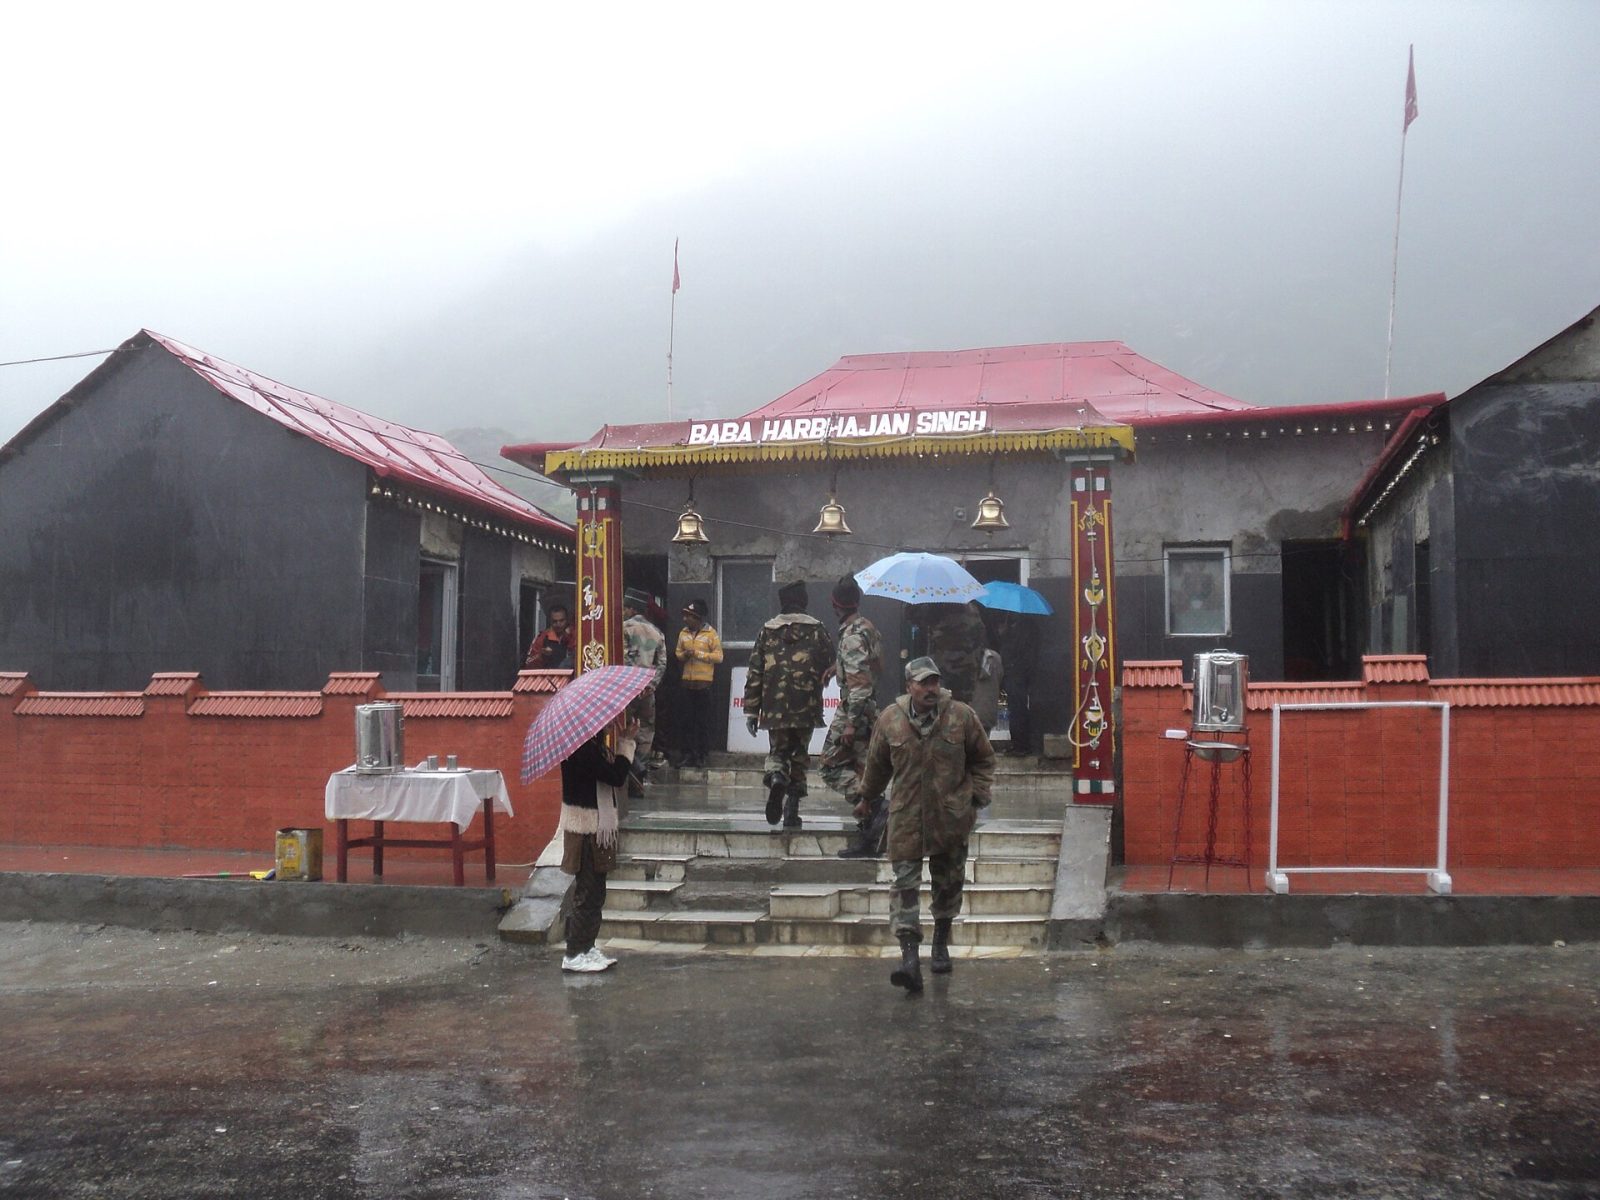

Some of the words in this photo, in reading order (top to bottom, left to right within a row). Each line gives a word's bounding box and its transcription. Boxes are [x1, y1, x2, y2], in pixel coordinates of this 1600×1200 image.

[688, 421, 753, 444] BABA
[761, 412, 911, 442] HARBHAJAN
[916, 410, 987, 433] SINGH
